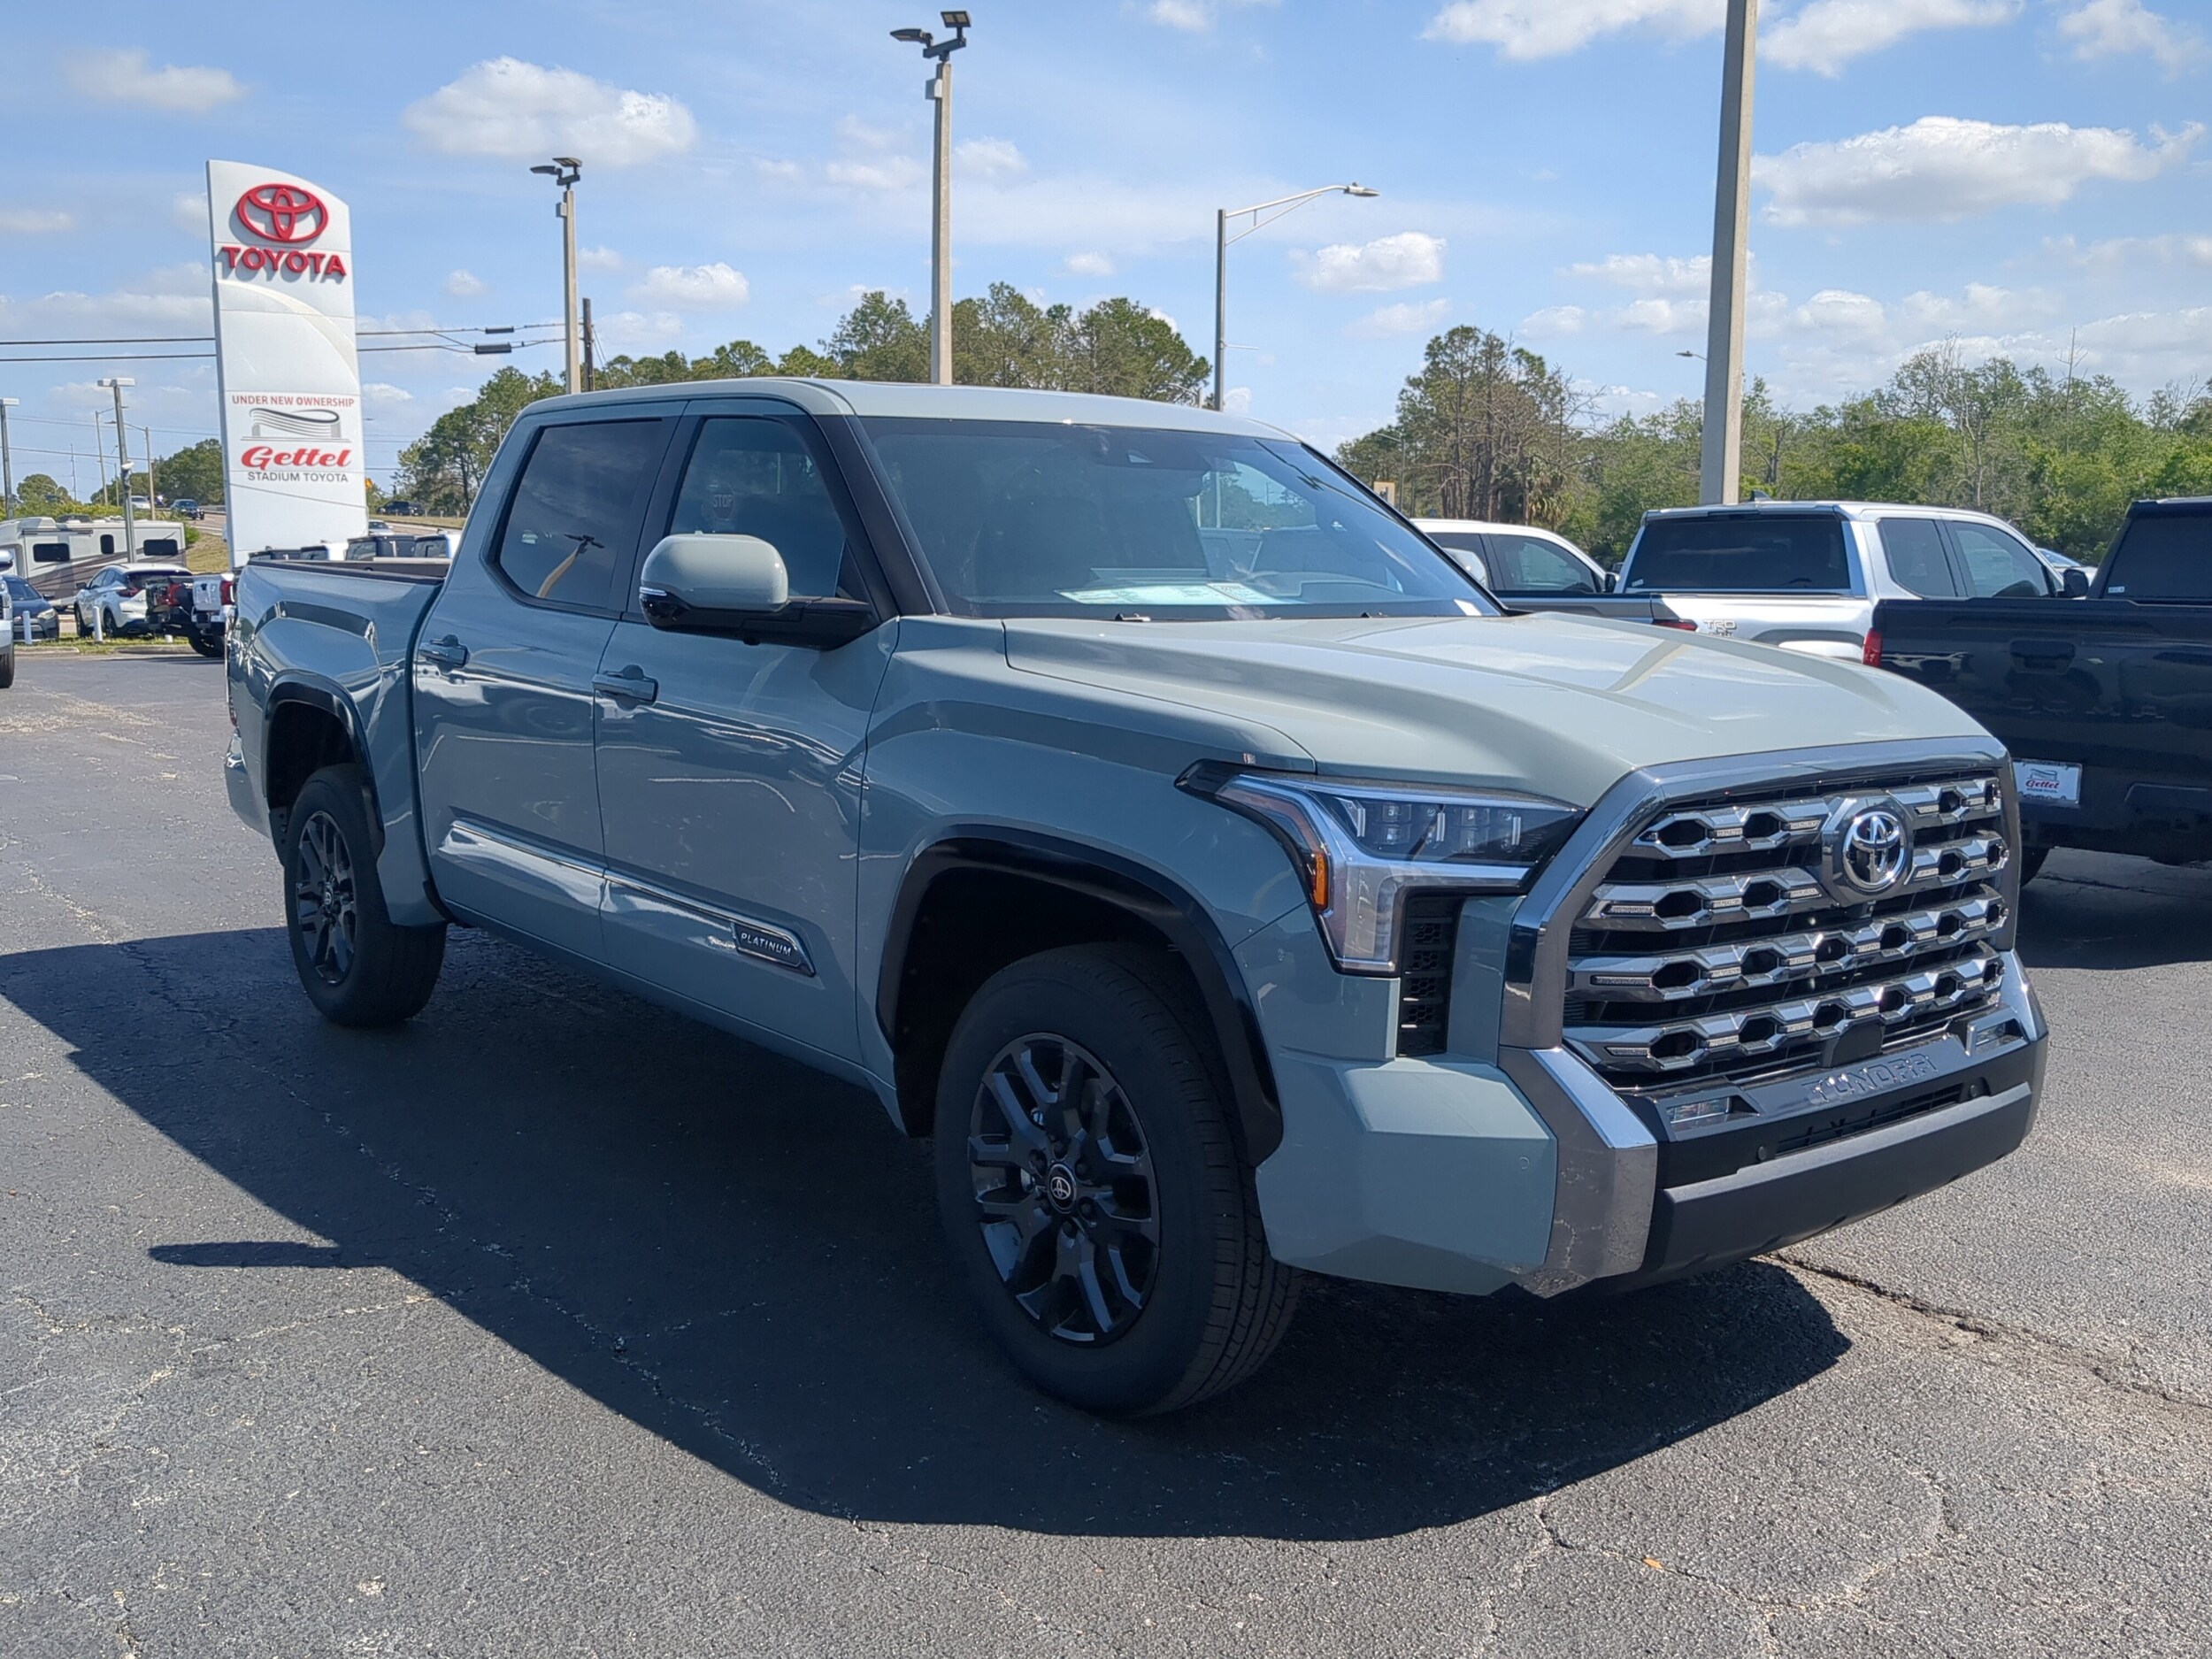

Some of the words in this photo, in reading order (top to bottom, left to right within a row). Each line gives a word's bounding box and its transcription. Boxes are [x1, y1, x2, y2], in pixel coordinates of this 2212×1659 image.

[222, 246, 346, 276] TOYOTA
[232, 395, 270, 405] UNDER
[271, 396, 294, 405] NEW
[296, 396, 355, 407] OWNERSHIP
[241, 445, 352, 471] Gettel
[248, 472, 300, 482] STADIUM
[303, 472, 349, 482] TOYOTA
[713, 494, 733, 508] STOP
[1703, 618, 1737, 631] TRD
[2025, 779, 2060, 789] Gettel
[741, 932, 792, 956] PLATINUM
[1801, 1053, 1939, 1102] TUNDRA
